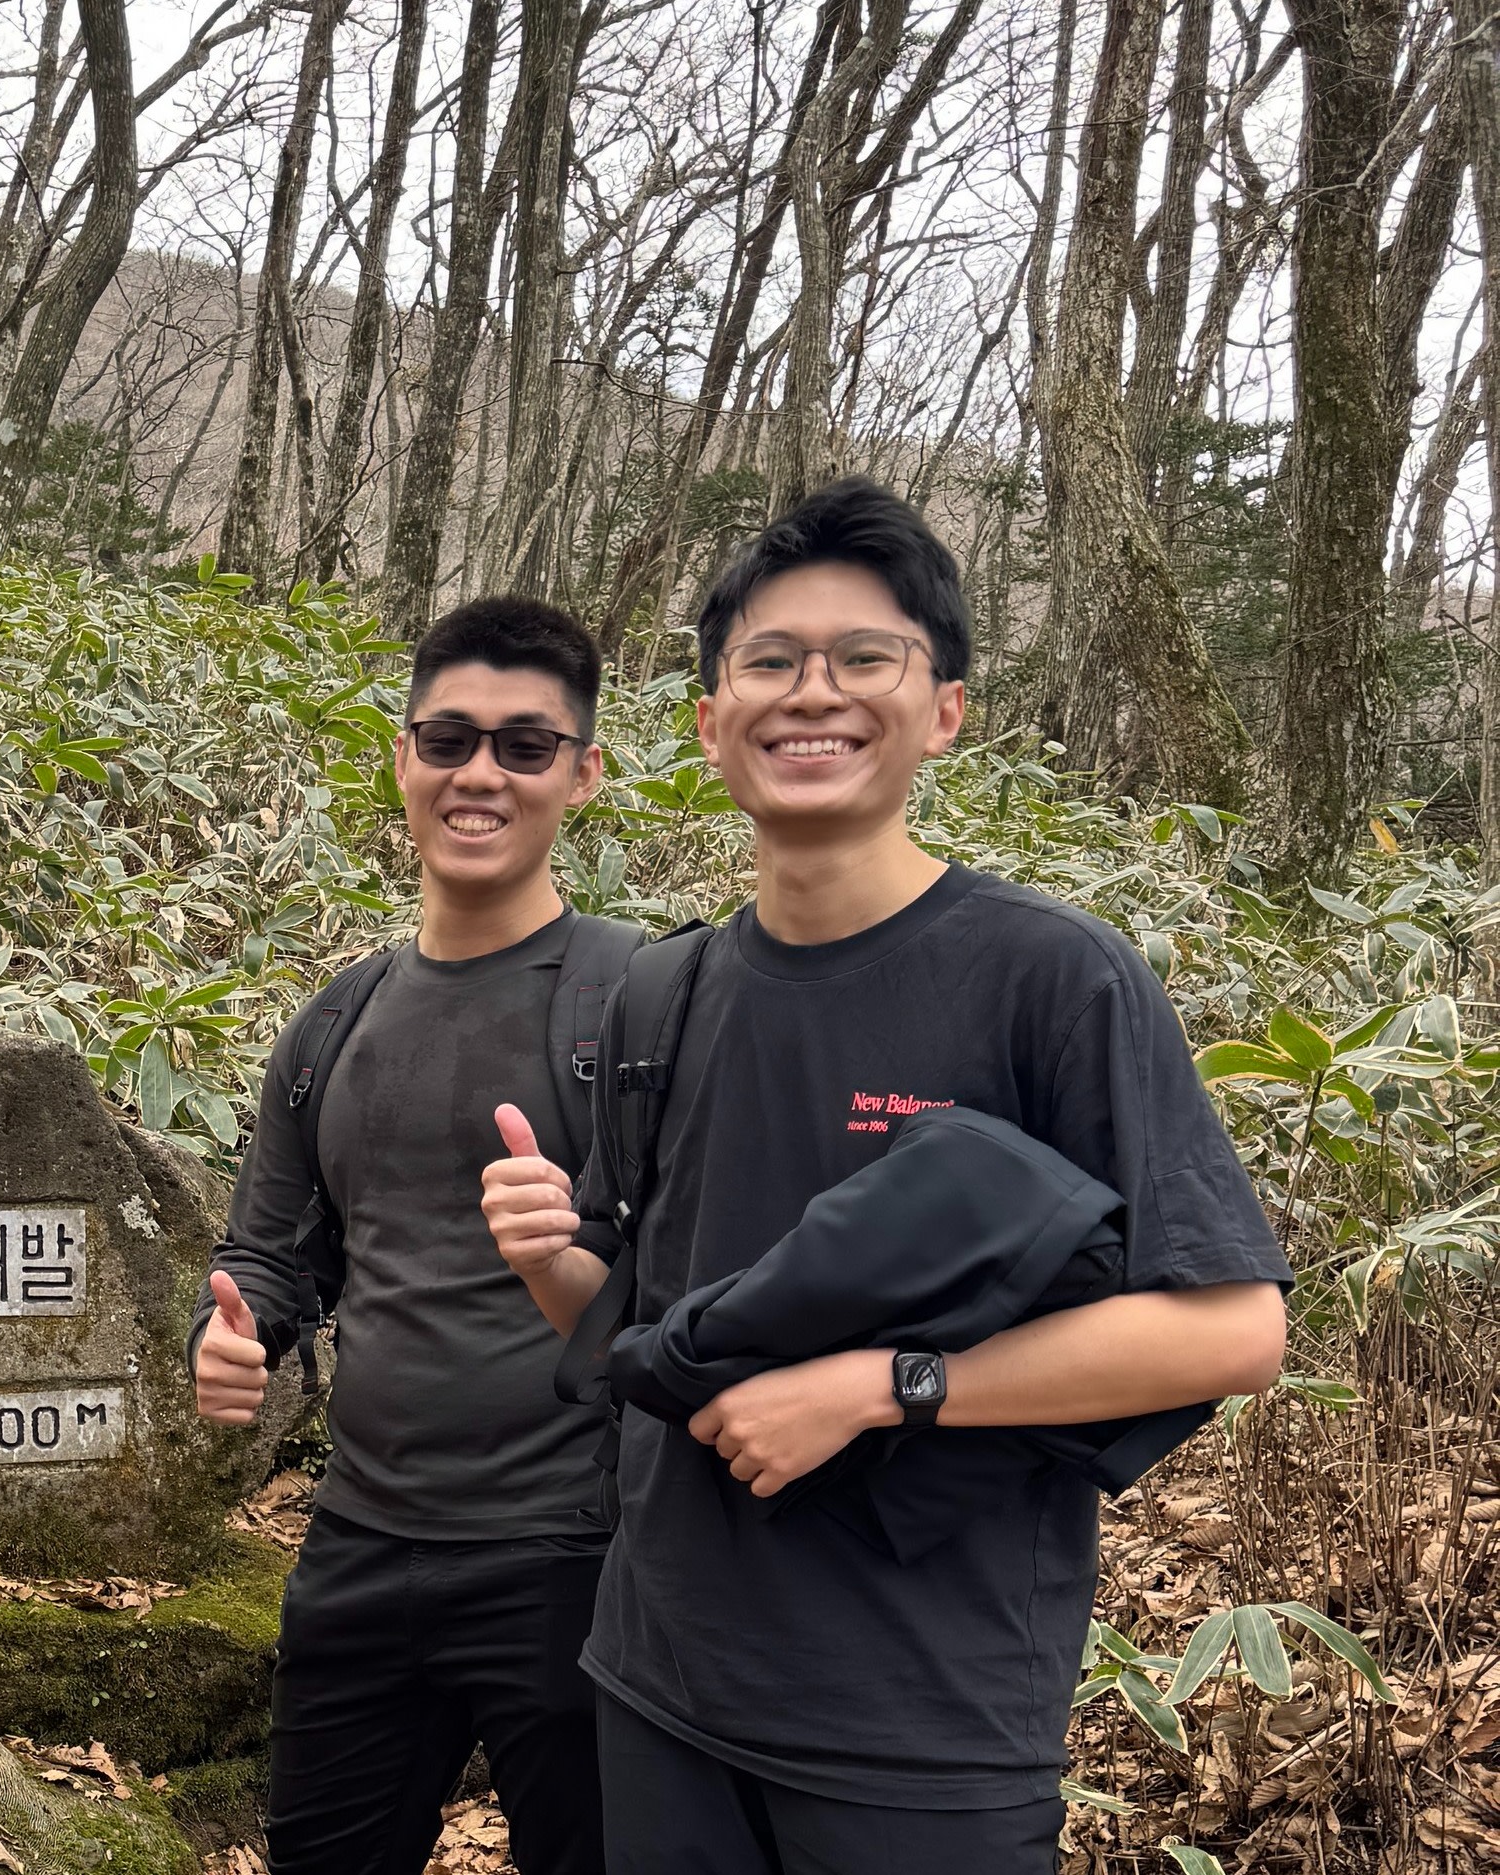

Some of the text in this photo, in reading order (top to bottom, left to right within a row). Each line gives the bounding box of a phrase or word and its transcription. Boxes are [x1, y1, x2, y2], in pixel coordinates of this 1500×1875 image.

[851, 1091, 886, 1112] New
[846, 1120, 889, 1132] since 1906
[76, 1402, 107, 1426] M
